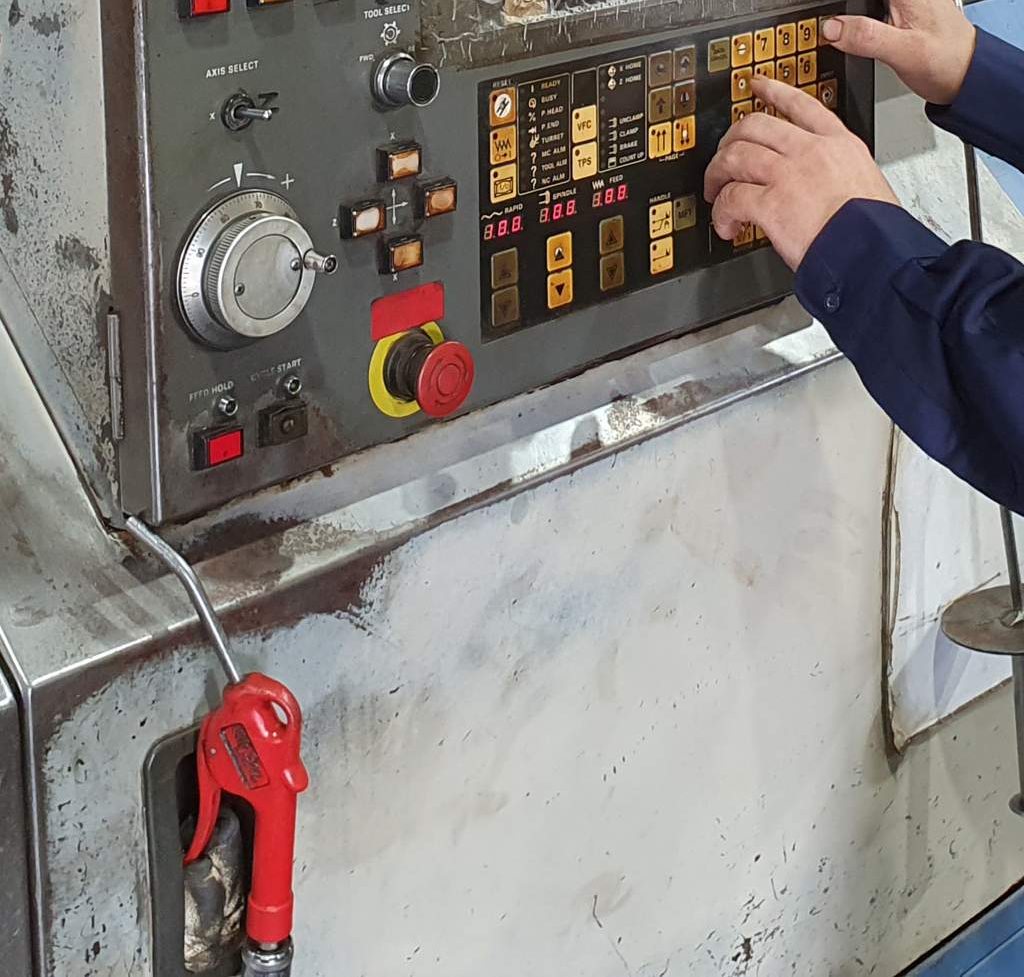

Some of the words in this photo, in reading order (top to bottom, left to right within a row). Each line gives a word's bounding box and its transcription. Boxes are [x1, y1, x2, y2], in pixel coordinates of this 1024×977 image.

[363, 9, 383, 19] TOOL
[782, 32, 790, 46] 8
[803, 27, 811, 41] 9
[761, 37, 768, 51] 7
[206, 66, 226, 78] AXIS
[228, 60, 259, 74] SELECT
[803, 60, 811, 74] 6
[541, 94, 558, 103] BUSY
[577, 119, 592, 131] VFC
[619, 127, 639, 138] CLAMP
[619, 140, 638, 151] BRAKE
[577, 157, 592, 168] TPS
[552, 173, 565, 182] ALM
[609, 174, 624, 184] FEED
[552, 188, 577, 200] SPINDLE
[504, 203, 523, 214] RAPID
[276, 358, 302, 374] START
[211, 380, 234, 394] HOLD
